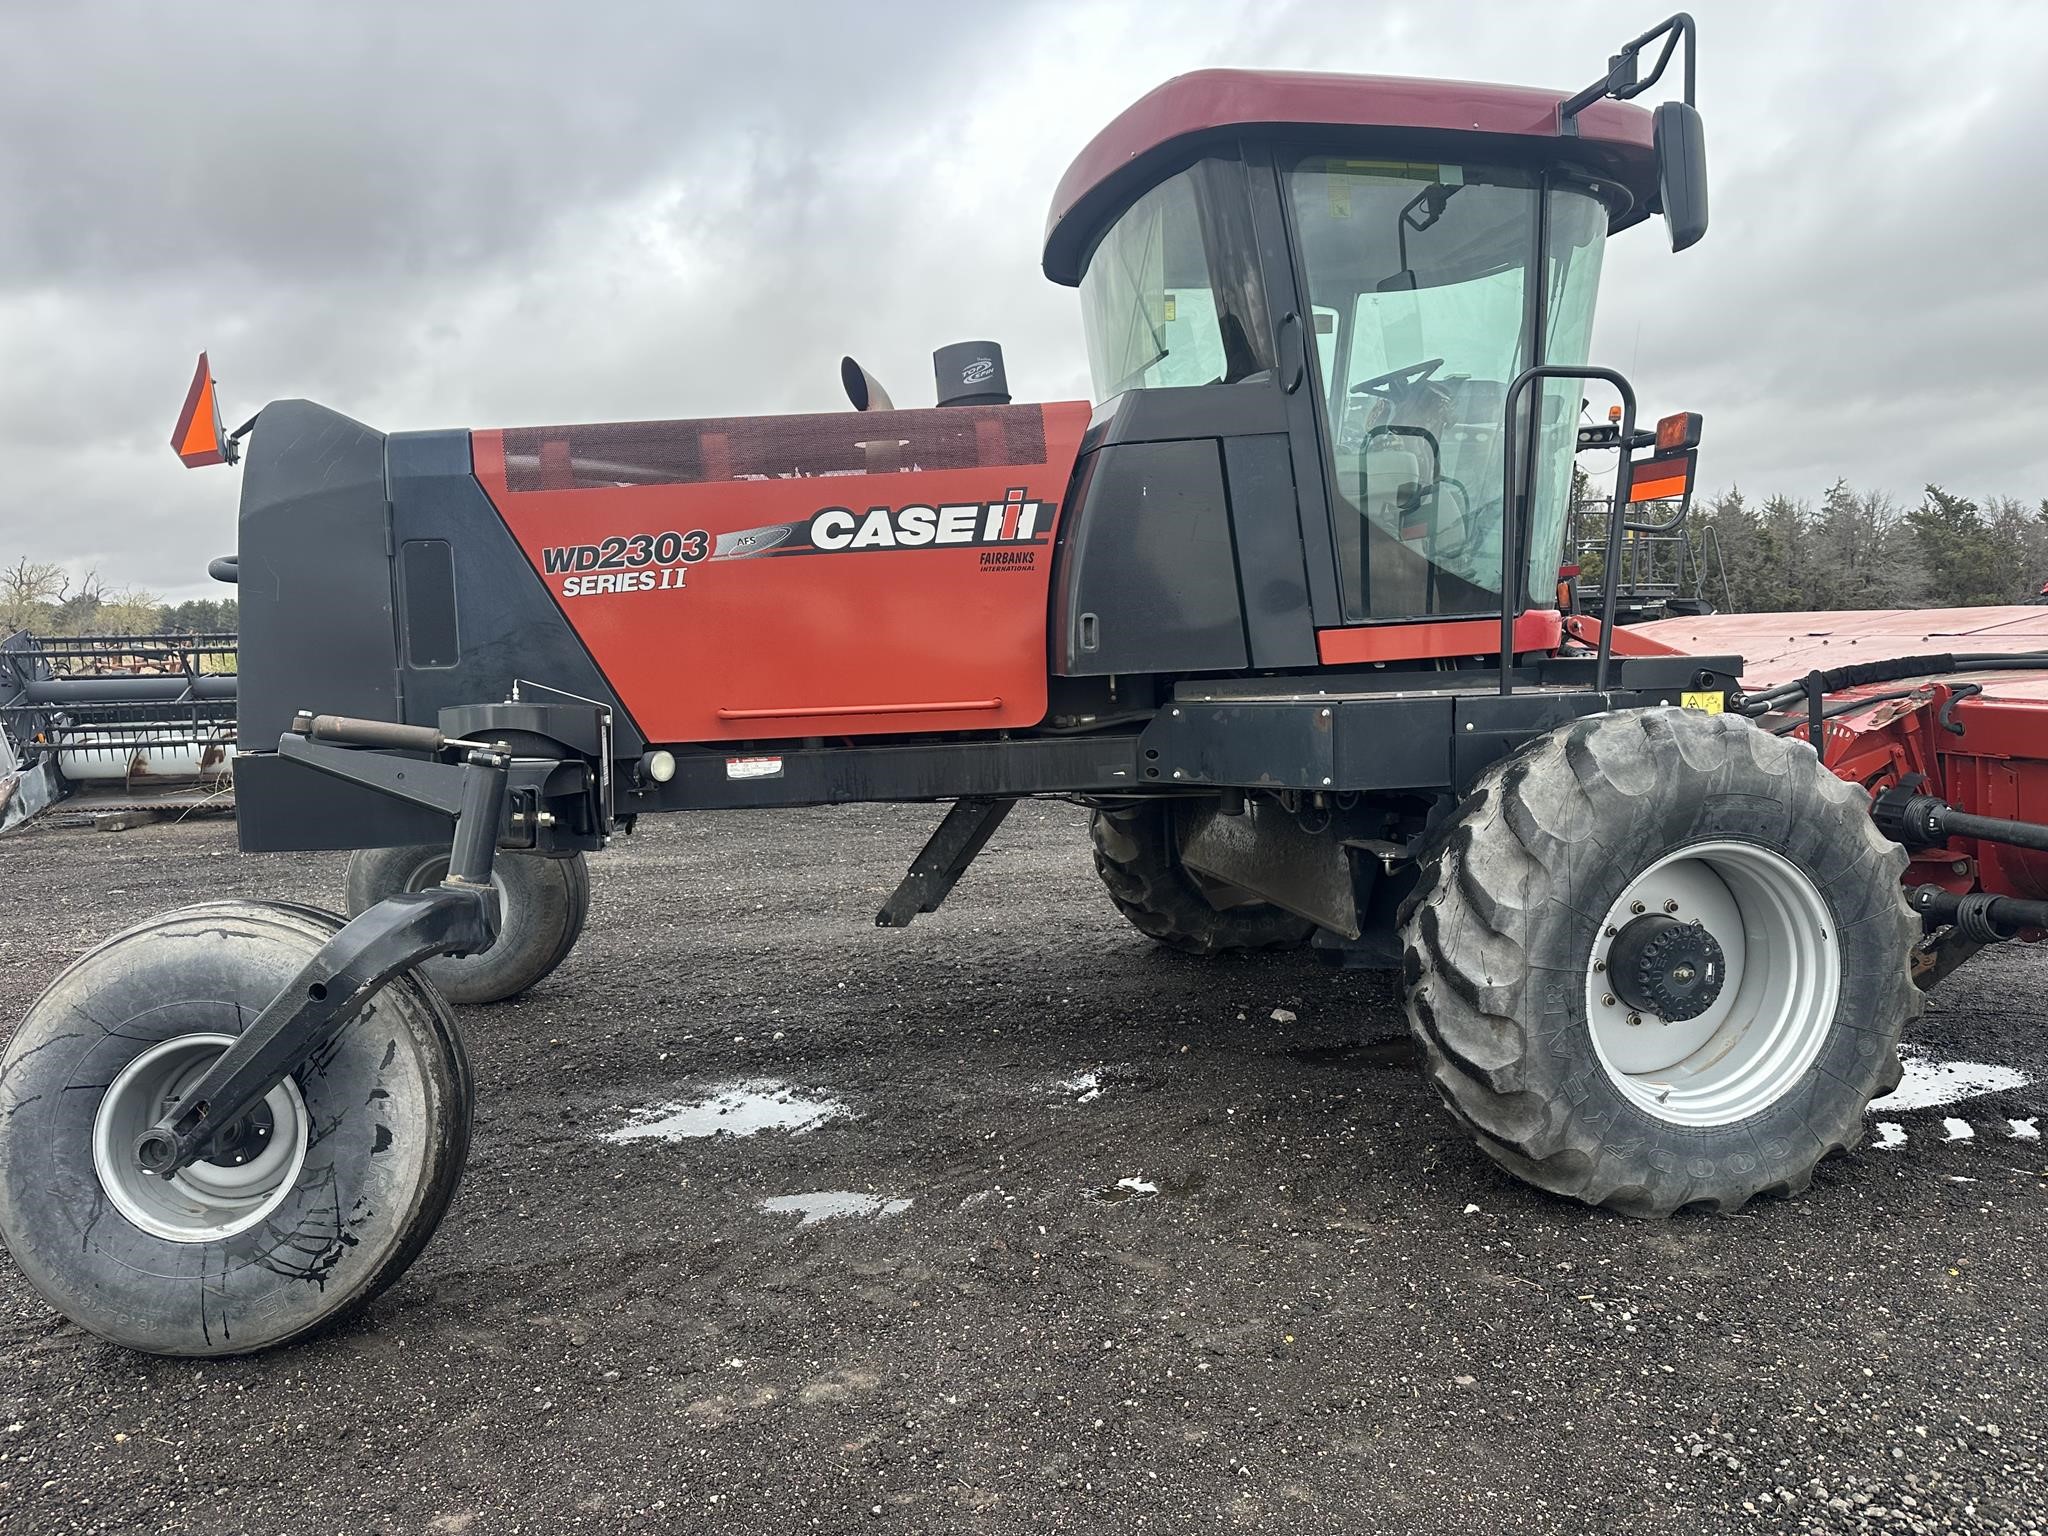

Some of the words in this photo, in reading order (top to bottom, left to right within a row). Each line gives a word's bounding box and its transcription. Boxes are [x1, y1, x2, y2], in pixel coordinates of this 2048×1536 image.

[811, 505, 978, 549] CASE
[543, 529, 710, 574] WD2303
[736, 535, 757, 546] AFS
[979, 551, 1036, 566] FAIRBANKS
[980, 563, 1037, 572] INTERNATIONAL
[562, 573, 657, 598] SERIES
[658, 567, 688, 591] II
